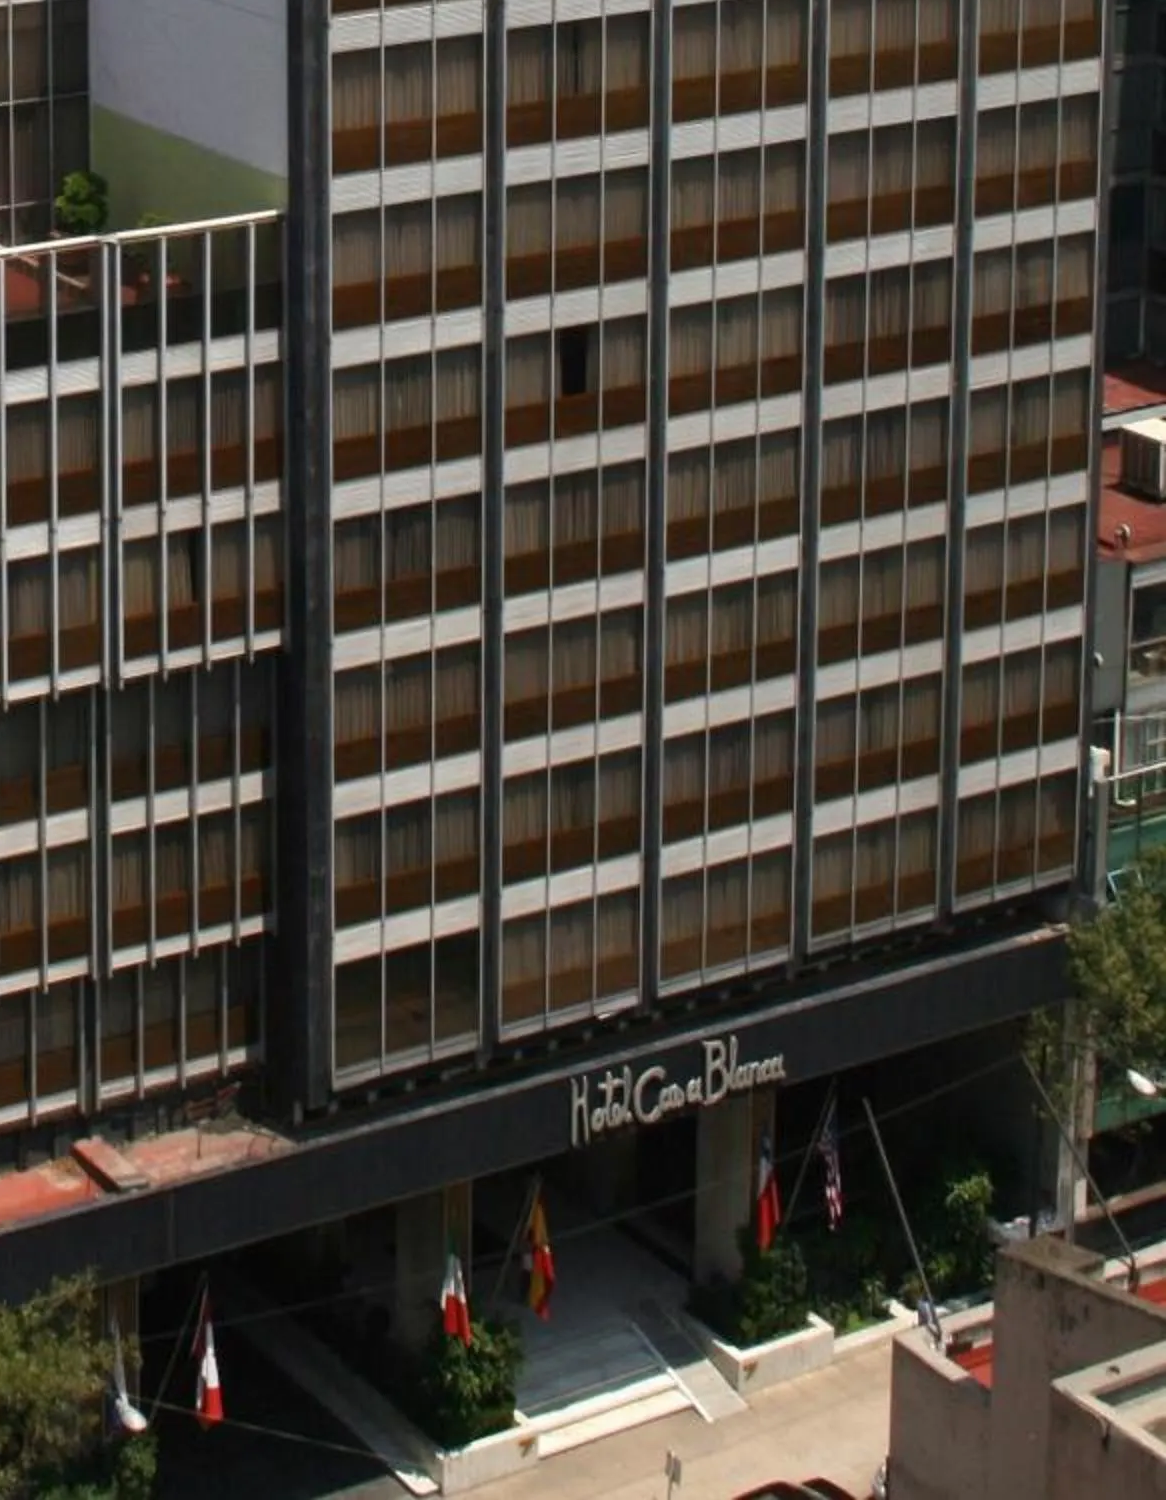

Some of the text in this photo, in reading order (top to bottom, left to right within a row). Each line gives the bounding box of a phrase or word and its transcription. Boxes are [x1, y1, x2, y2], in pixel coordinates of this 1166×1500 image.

[570, 1035, 786, 1149] Hotel Casa Blanca
